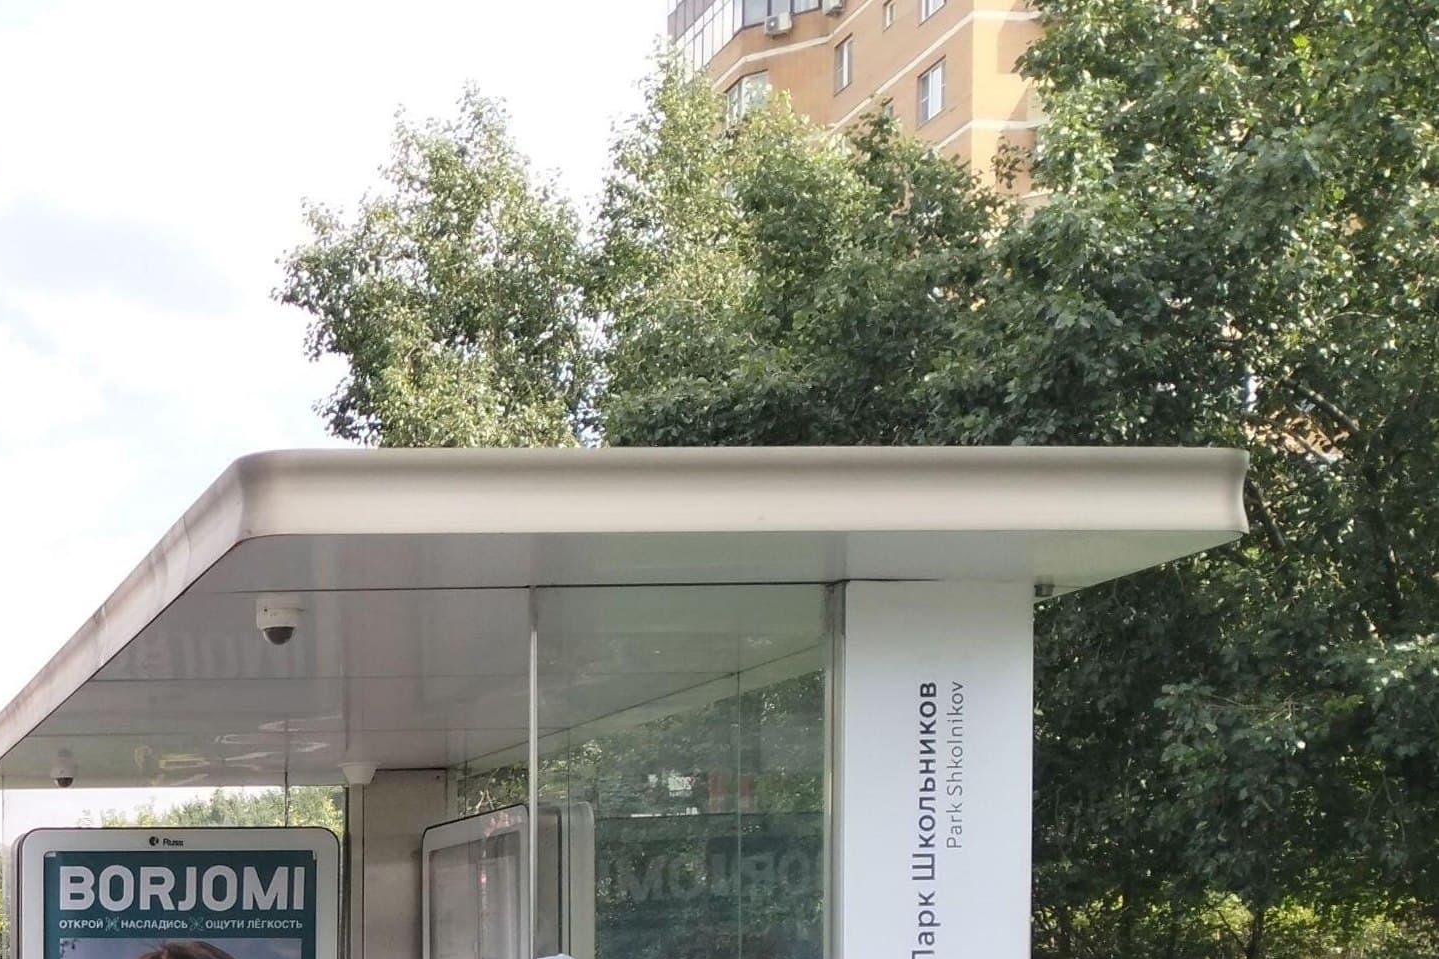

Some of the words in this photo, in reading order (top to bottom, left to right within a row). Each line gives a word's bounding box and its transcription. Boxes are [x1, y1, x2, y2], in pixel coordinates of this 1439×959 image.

[946, 681, 964, 796] Shkolnikov
[911, 681, 937, 881] Школьников
[946, 801, 963, 848] Park
[59, 865, 305, 911] BORJOMI
[59, 917, 104, 930] ОТКРОЙ
[121, 919, 188, 931] НАСЛАДИСЬ
[205, 919, 244, 931] ОЩУТИ
[246, 917, 303, 930] ЛЁГКОСТЬ
